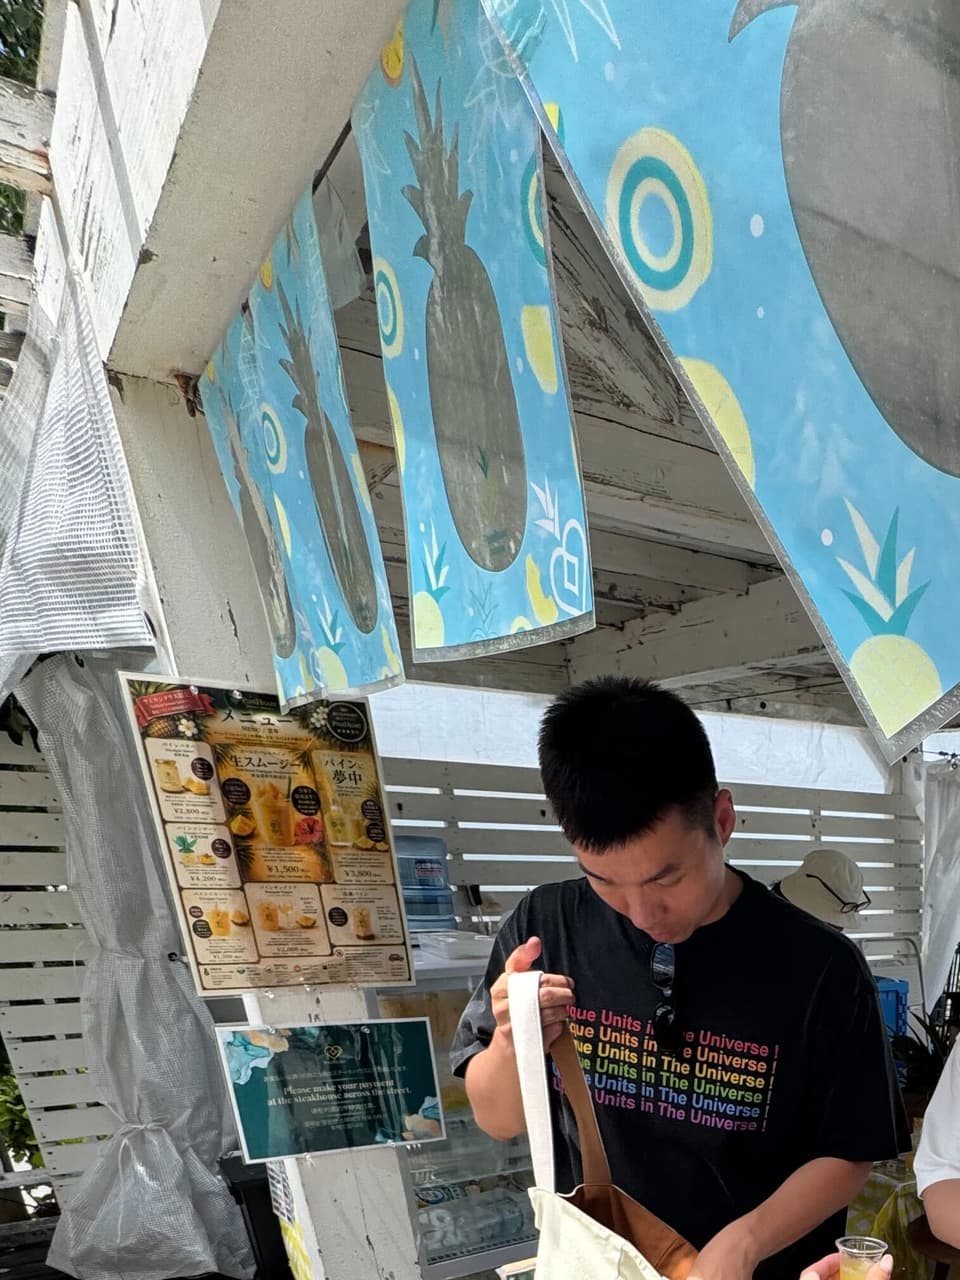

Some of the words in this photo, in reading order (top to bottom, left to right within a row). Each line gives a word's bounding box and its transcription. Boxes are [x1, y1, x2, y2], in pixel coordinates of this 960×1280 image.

[222, 709, 293, 726] メニュー
[231, 755, 301, 770] 生スムージー
[332, 770, 363, 785] 夢中
[566, 1005, 597, 1021] que
[601, 1009, 641, 1032] Units
[569, 1022, 595, 1038] que
[600, 1026, 639, 1048] Units
[643, 1035, 658, 1052] in
[699, 1030, 769, 1057] Universe
[774, 1044, 779, 1059] !
[598, 1042, 638, 1064] Units
[642, 1052, 656, 1068] in
[661, 1055, 690, 1075] The
[695, 1062, 765, 1089] Universe
[769, 1076, 774, 1089] !
[696, 1046, 767, 1073] Universe
[771, 1061, 777, 1075] !
[283, 1085, 312, 1095] Please
[312, 1083, 336, 1092] make
[337, 1083, 357, 1091] your
[359, 1079, 394, 1090] payment
[594, 1073, 637, 1094] Units
[641, 1082, 654, 1098] in
[659, 1086, 687, 1105] The
[692, 1093, 760, 1118] Universe
[764, 1105, 769, 1118] !
[596, 1058, 637, 1079] Units
[642, 1067, 655, 1083] in
[660, 1071, 689, 1090] The
[693, 1078, 763, 1103] Universe
[766, 1090, 772, 1104] !
[268, 1098, 277, 1106] at
[277, 1096, 292, 1105] the
[294, 1092, 343, 1103] steakhouse
[343, 1090, 370, 1099] across
[372, 1088, 384, 1096] the
[594, 1089, 636, 1110] Units
[640, 1097, 654, 1113] in
[658, 1101, 686, 1120] The
[690, 1108, 758, 1131] Universe
